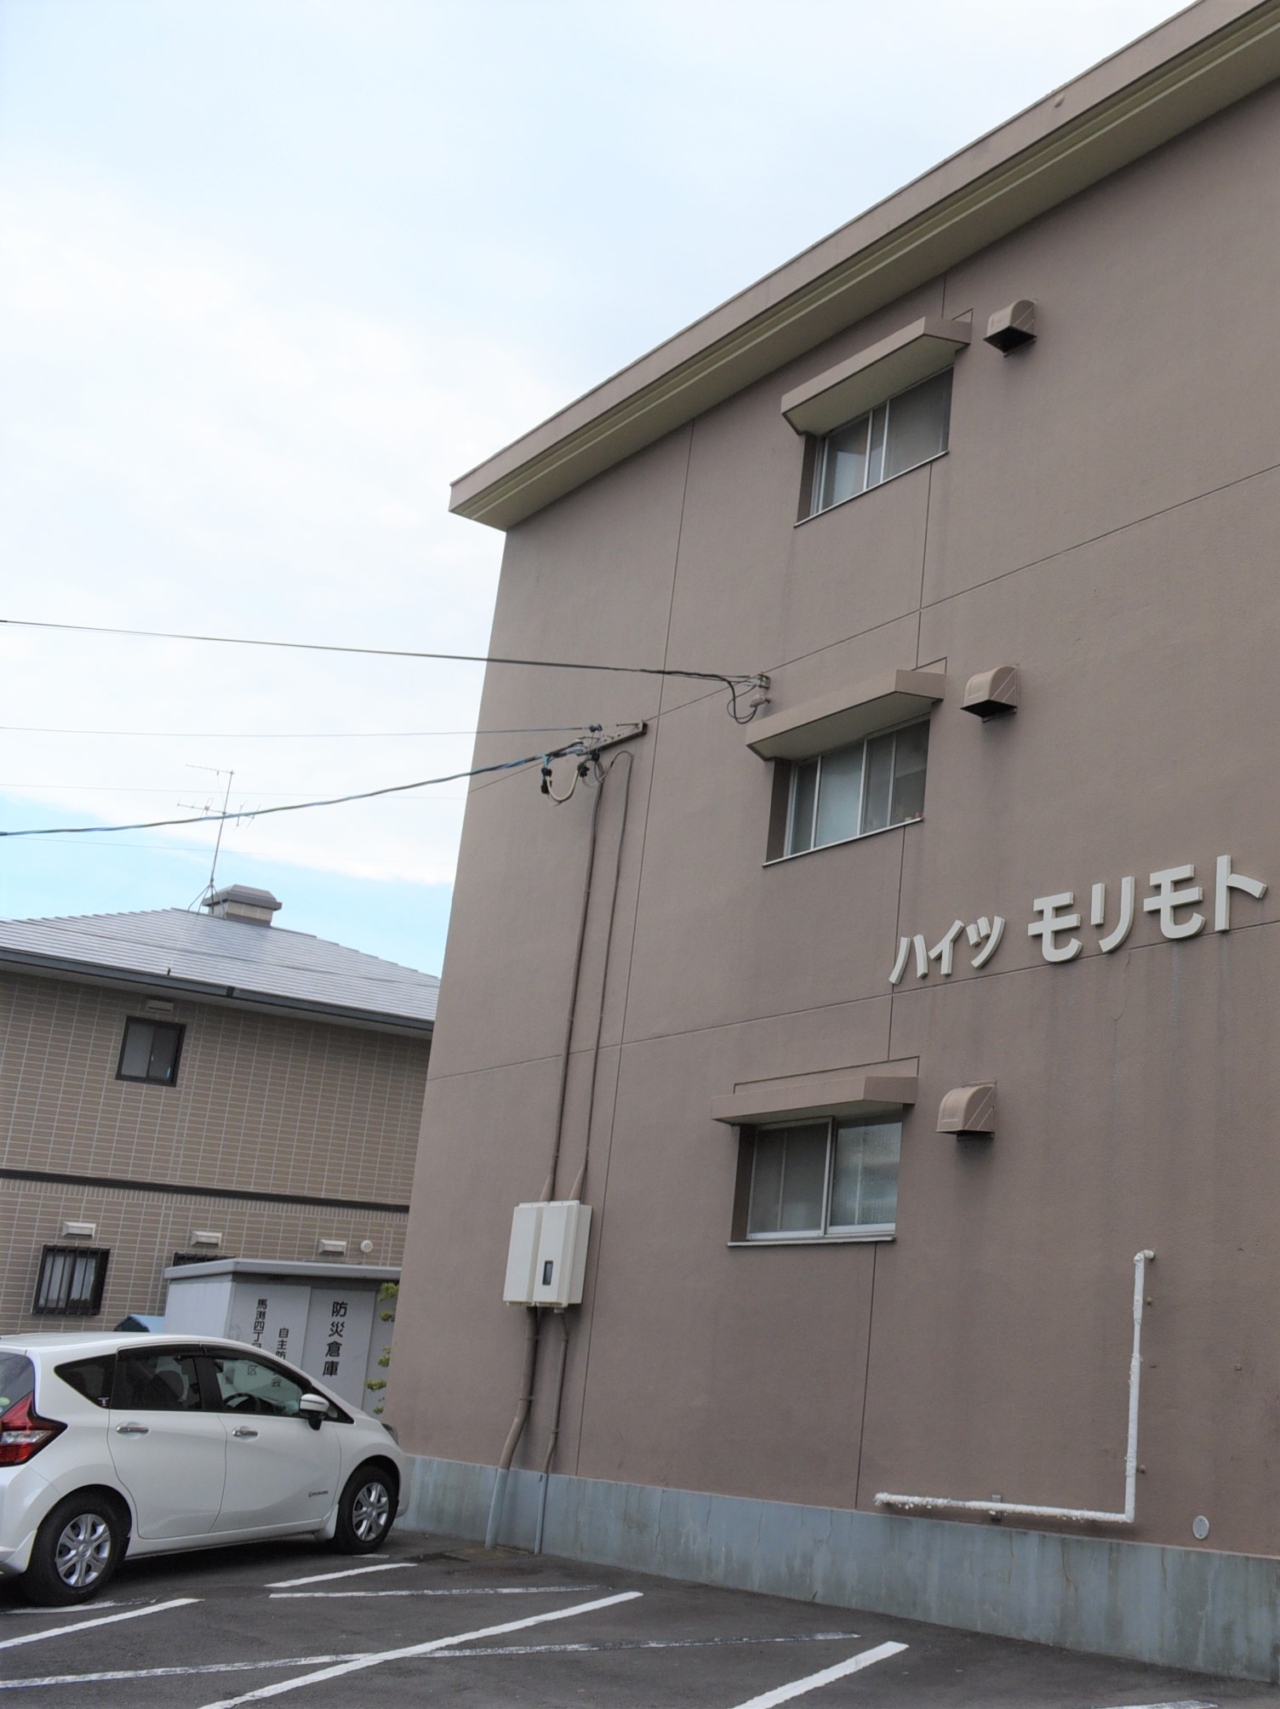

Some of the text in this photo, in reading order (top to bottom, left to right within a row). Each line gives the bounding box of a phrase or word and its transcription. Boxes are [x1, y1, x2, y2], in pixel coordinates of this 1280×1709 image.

[888, 854, 1268, 985] ハイツ モリモト
[322, 1300, 348, 1377] 防災倉庫
